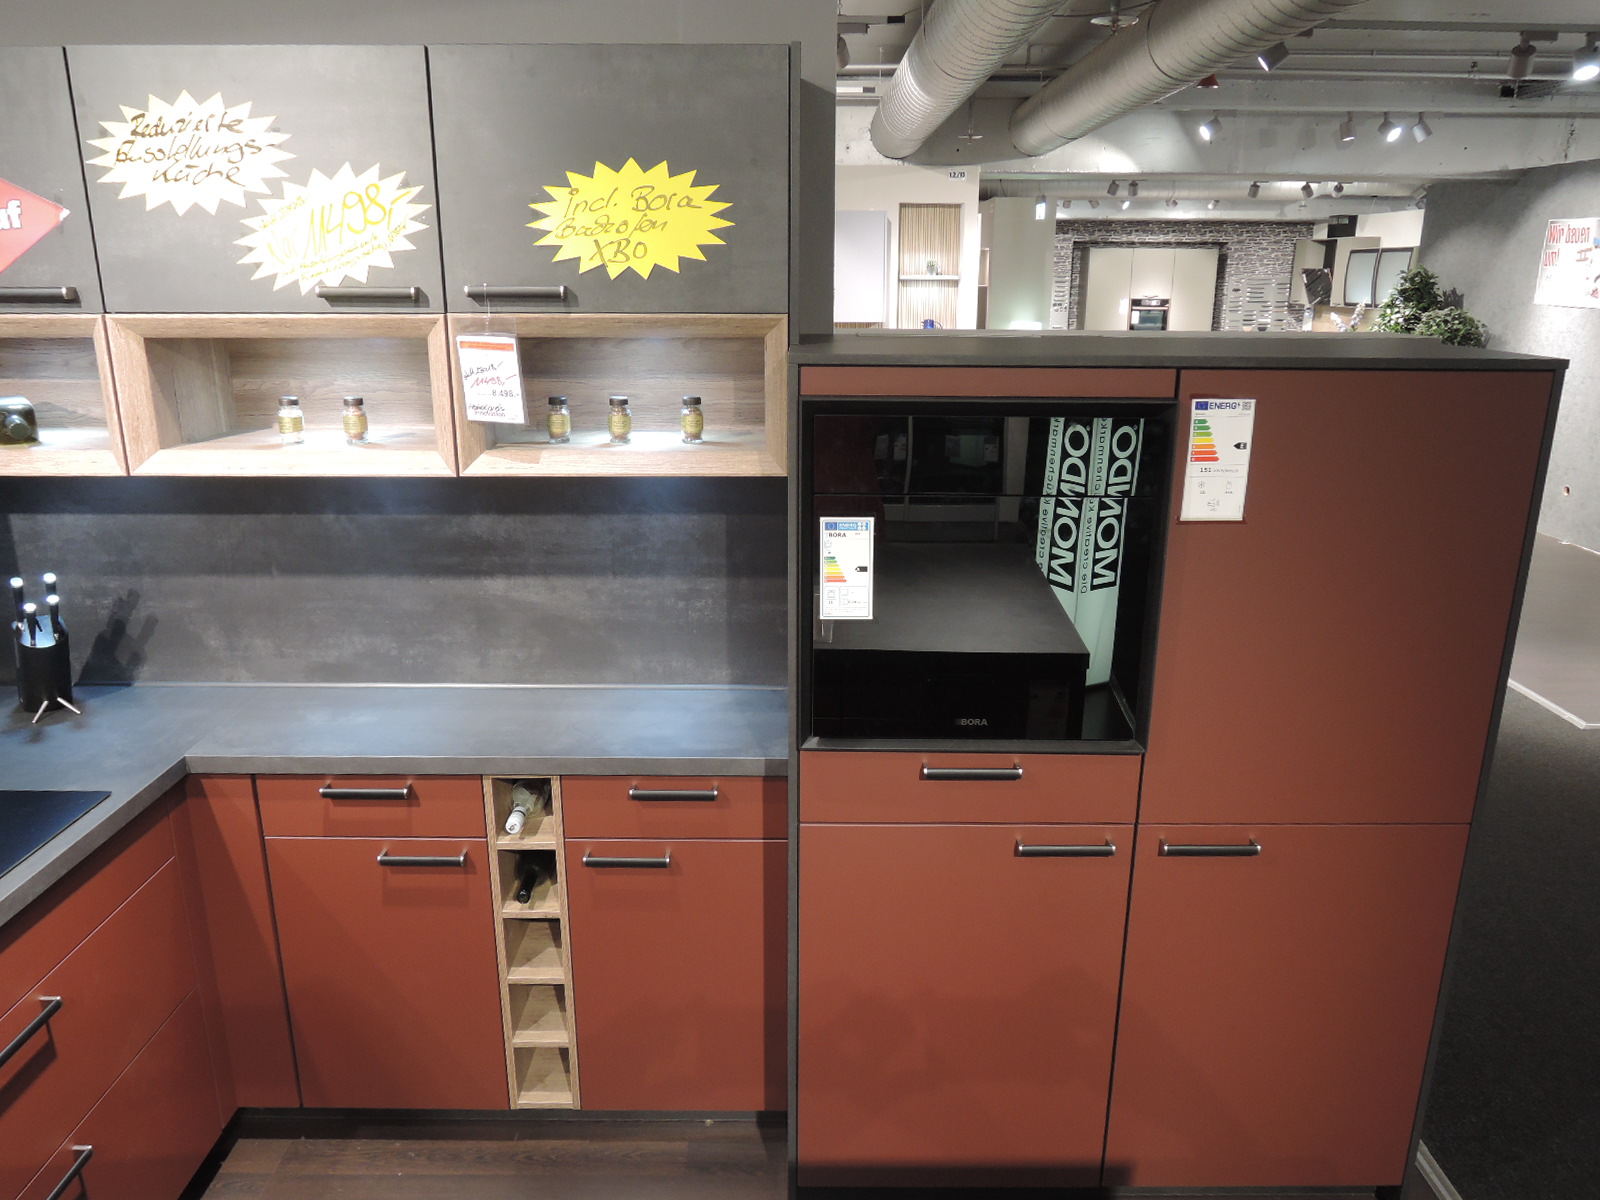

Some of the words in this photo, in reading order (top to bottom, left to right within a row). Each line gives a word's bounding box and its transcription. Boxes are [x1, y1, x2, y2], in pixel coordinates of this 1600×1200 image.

[631, 185, 703, 212] Bora
[1548, 224, 1564, 244] Wir
[589, 237, 648, 269] XBO
[961, 718, 988, 726] BORA
